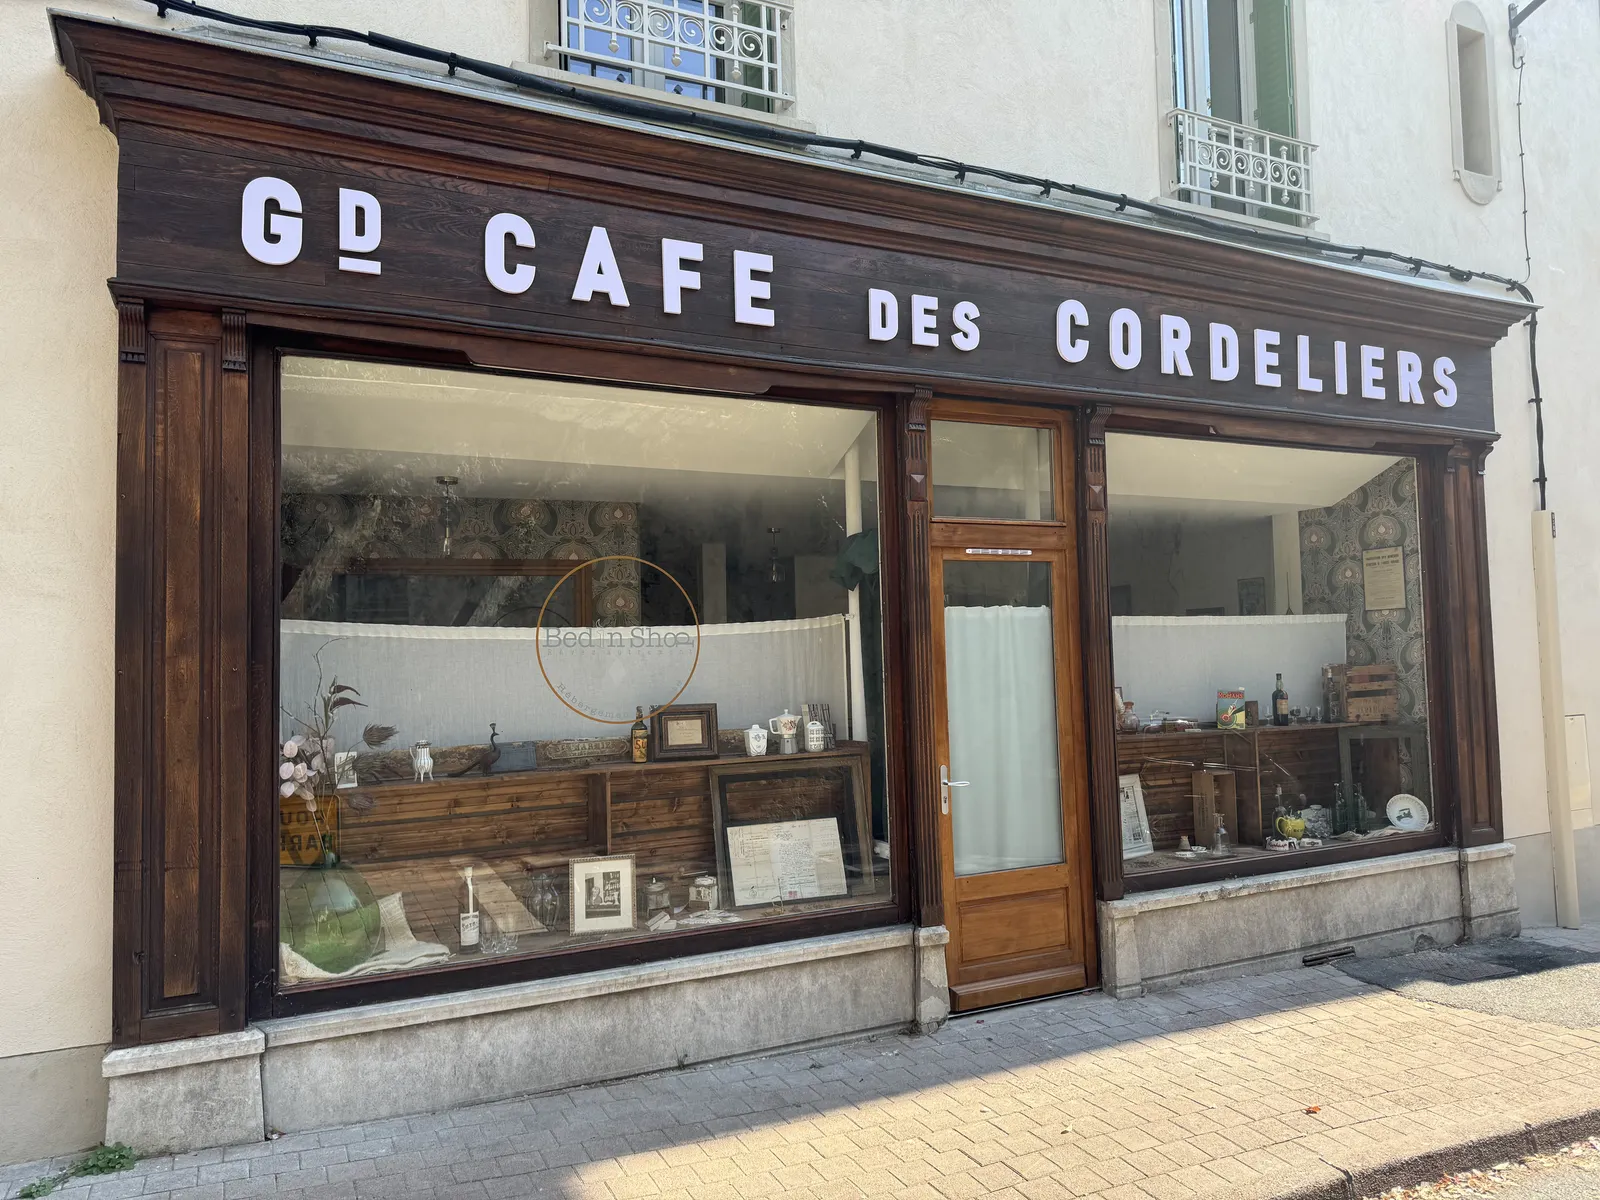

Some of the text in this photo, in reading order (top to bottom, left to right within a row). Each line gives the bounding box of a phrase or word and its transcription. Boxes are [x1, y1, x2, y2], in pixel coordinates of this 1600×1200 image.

[485, 213, 774, 326] CAFE
[869, 288, 980, 351] DES
[1057, 299, 1458, 407] CORDELIERS
[542, 626, 593, 648] Bed
